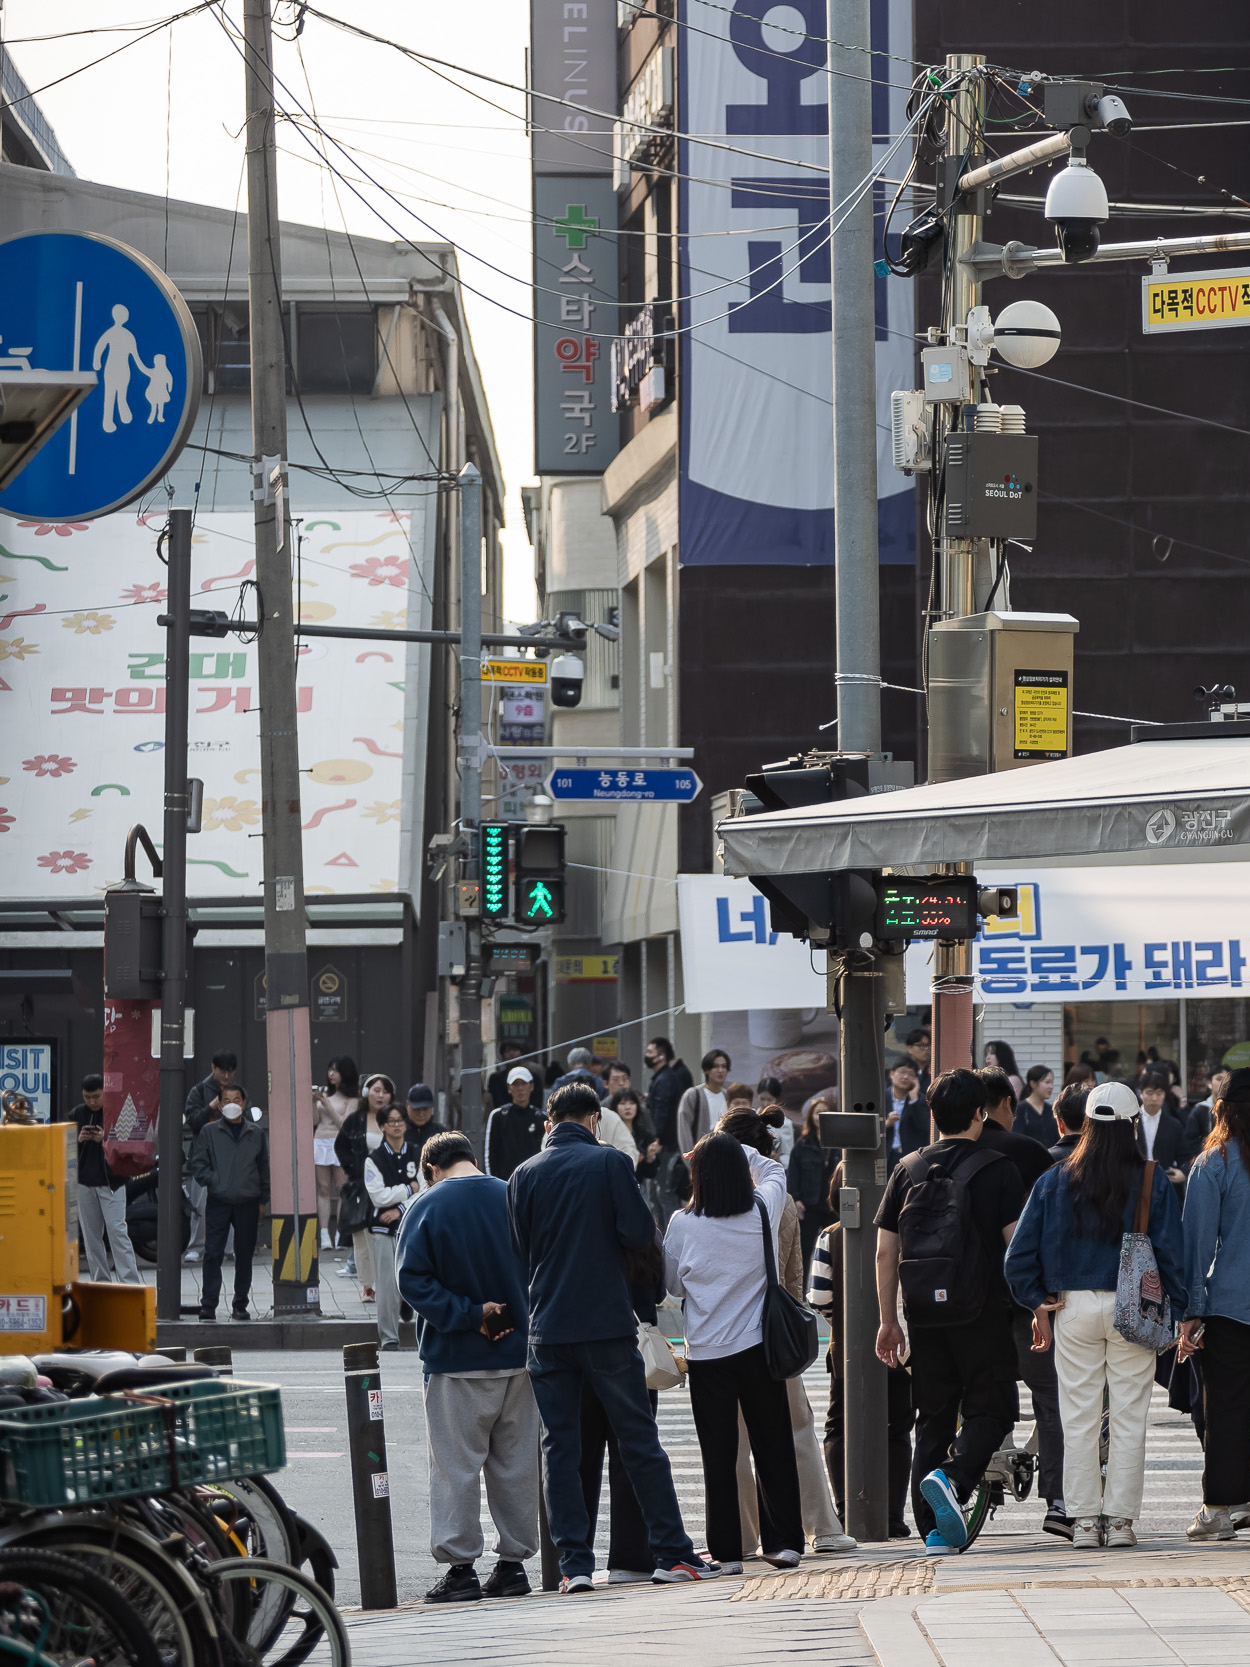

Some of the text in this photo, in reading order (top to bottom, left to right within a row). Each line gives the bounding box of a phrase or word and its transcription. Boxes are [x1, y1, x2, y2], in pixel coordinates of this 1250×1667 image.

[555, 252, 599, 428] 스타약국
[564, 433, 597, 454] 2F
[557, 771, 692, 790] 101 능동로 105
[593, 788, 655, 799] Neungdong-ro
[1182, 809, 1232, 830] 광진구
[979, 943, 1133, 994] 동료가
